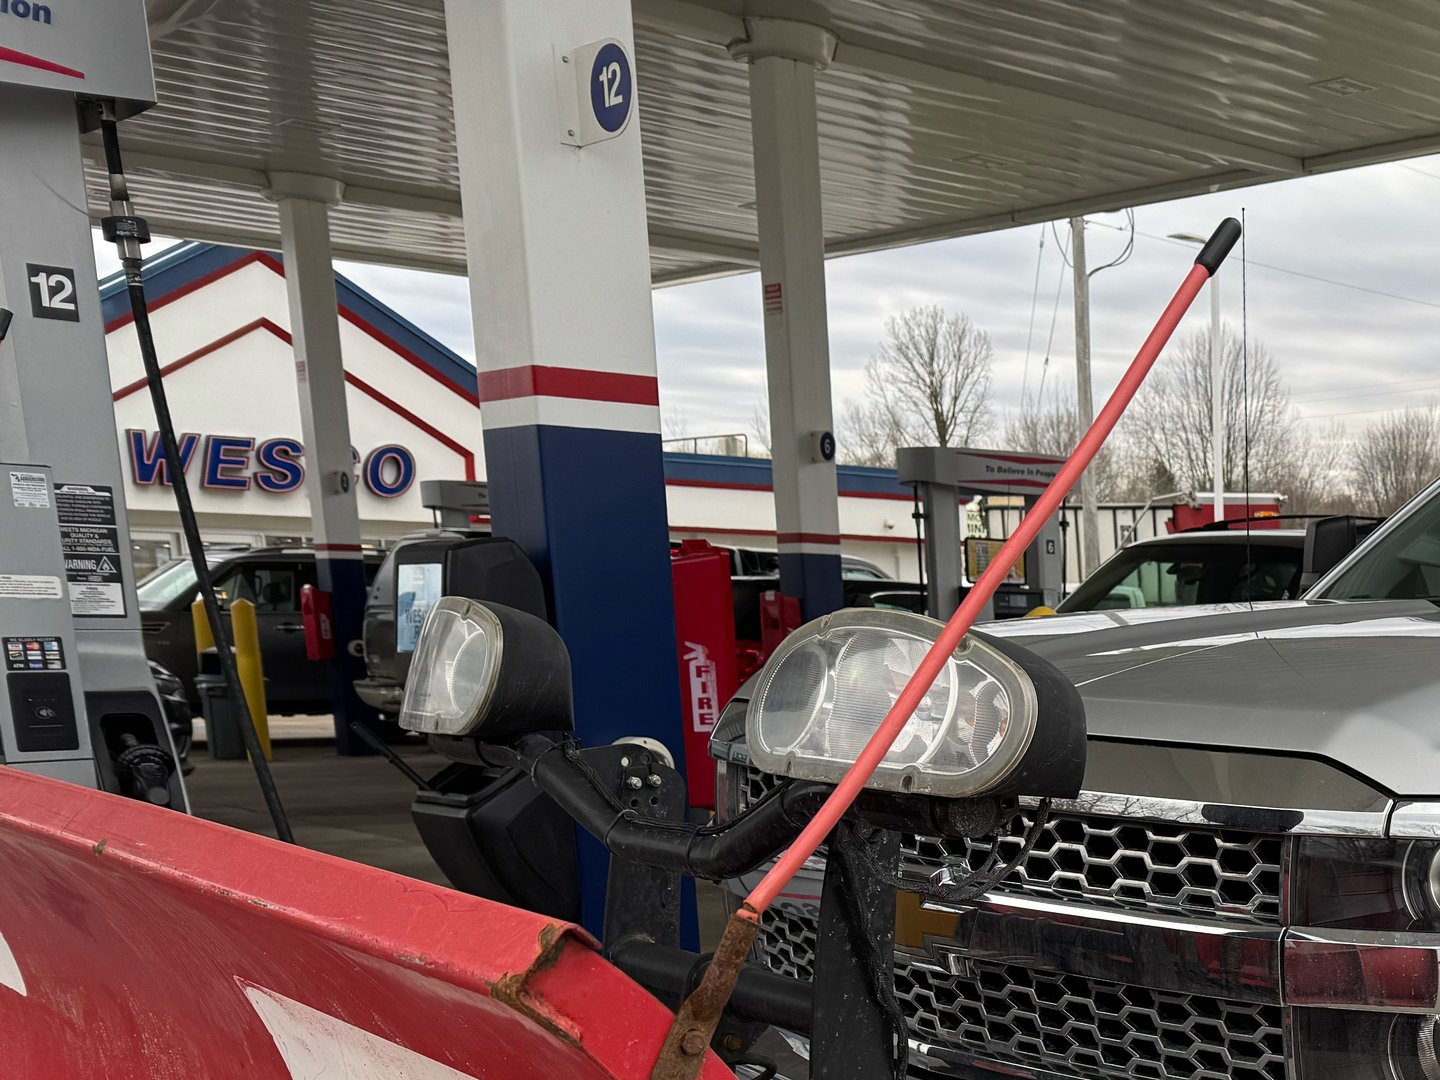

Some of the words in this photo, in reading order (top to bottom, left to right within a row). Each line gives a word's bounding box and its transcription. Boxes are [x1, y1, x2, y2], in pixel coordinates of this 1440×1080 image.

[599, 61, 623, 108] 12
[30, 271, 75, 310] 12
[125, 428, 416, 498] WESO
[1048, 542, 1054, 553] 6
[695, 665, 714, 725] FIRE
